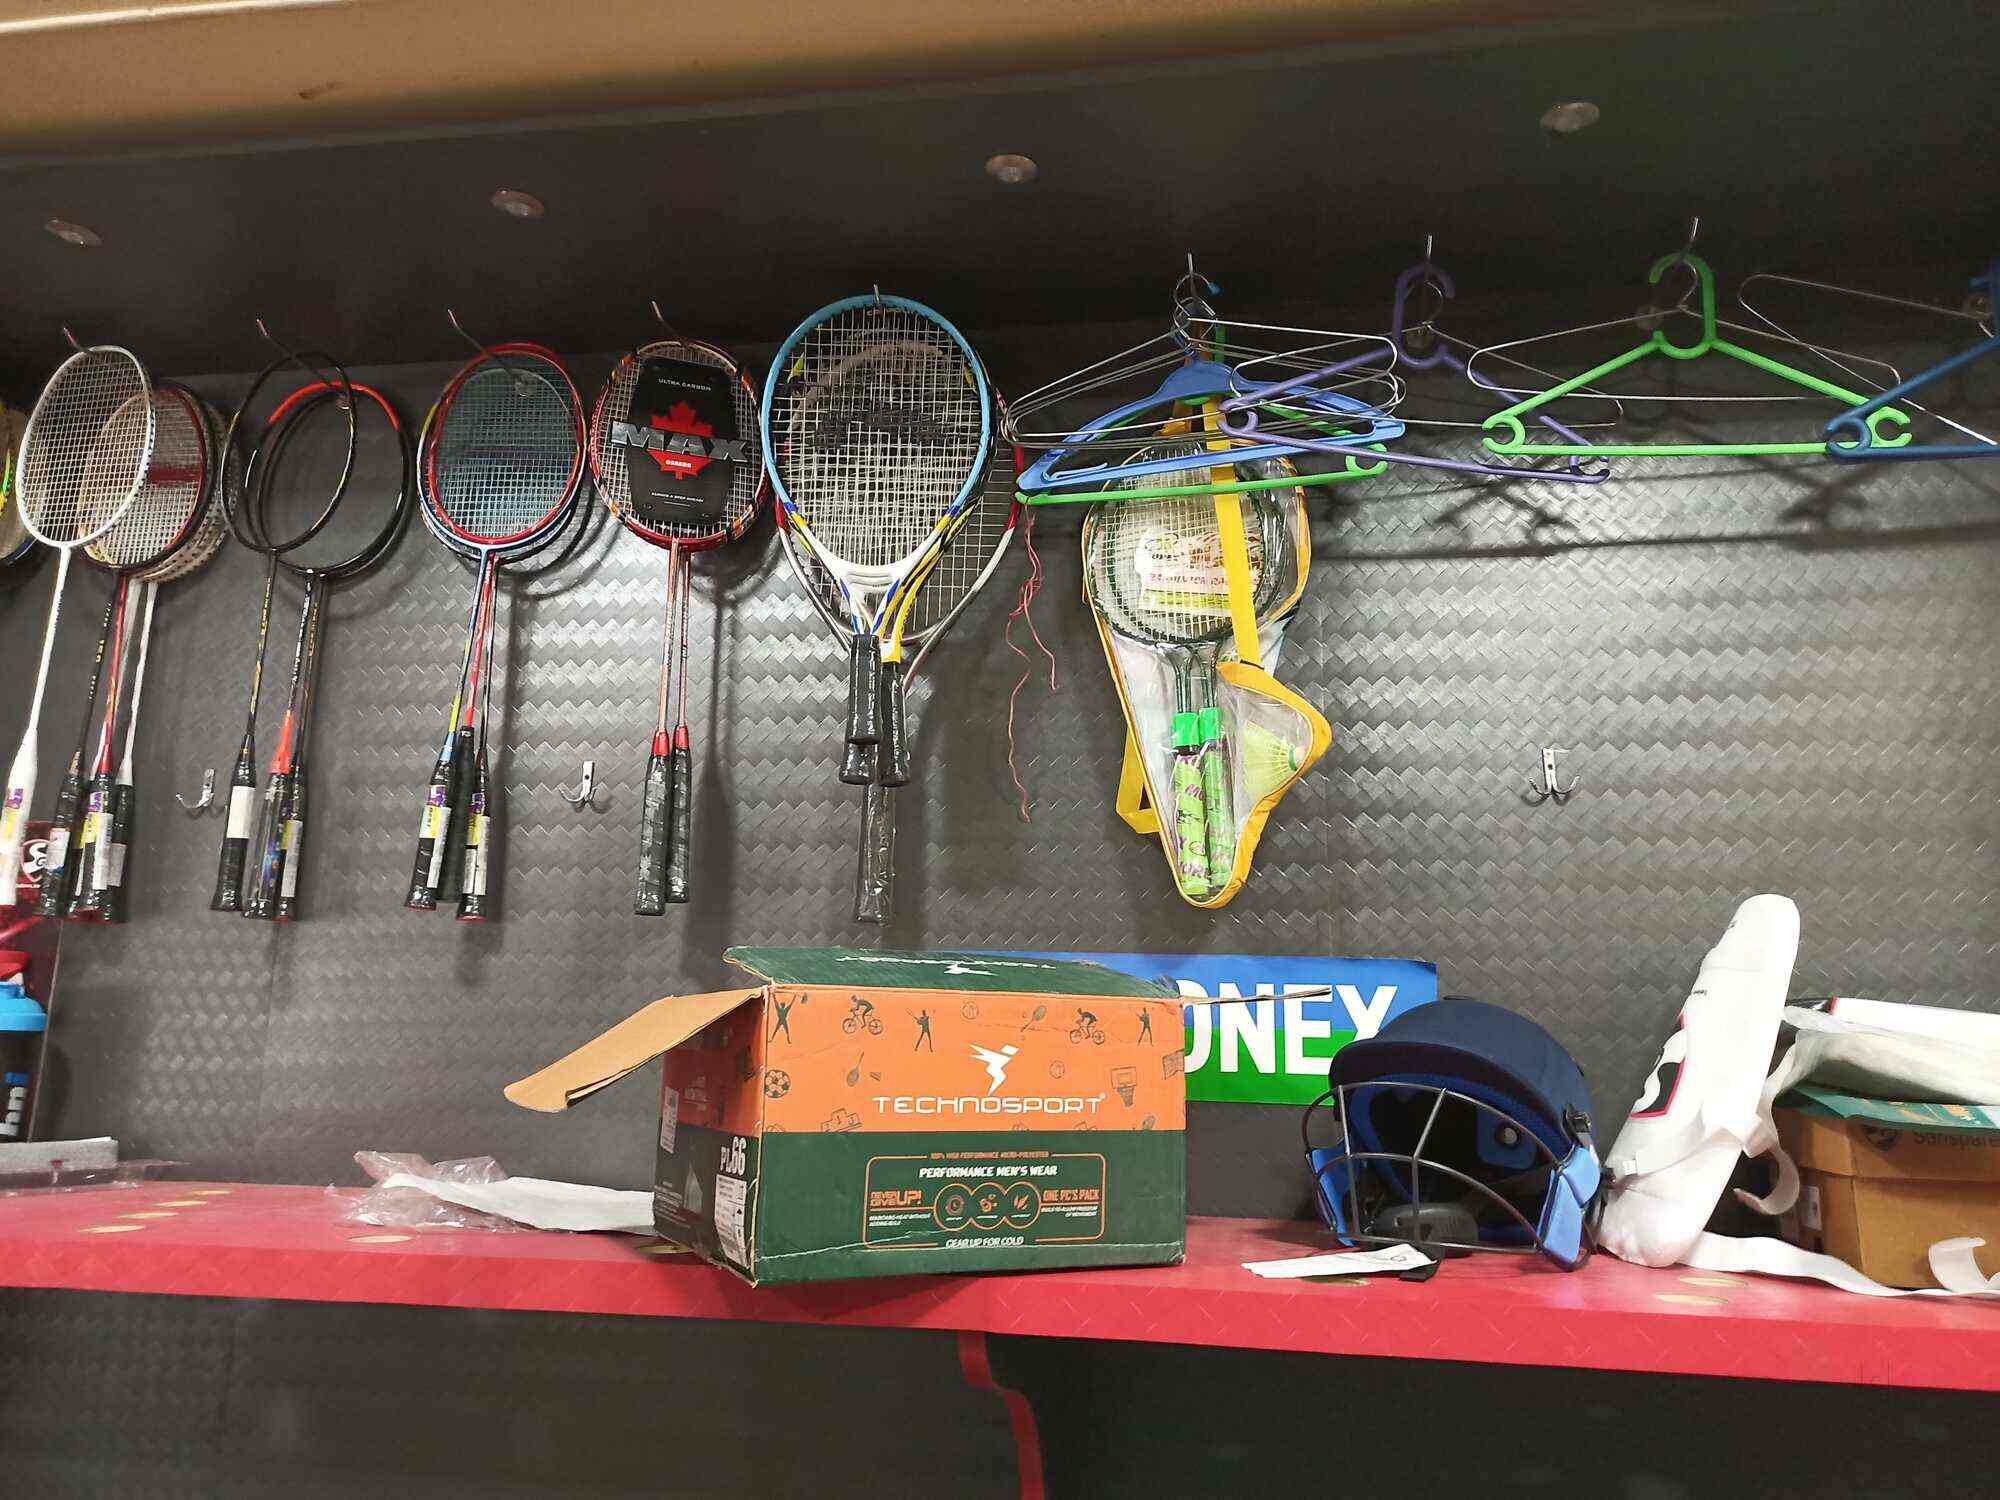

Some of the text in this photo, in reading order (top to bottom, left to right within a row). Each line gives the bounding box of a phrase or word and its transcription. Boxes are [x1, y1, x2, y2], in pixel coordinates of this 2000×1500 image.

[658, 378, 681, 387] ULTRA
[611, 420, 749, 463] MAX
[872, 1095, 1101, 1115] TECHNOSPORT
[919, 1164, 1059, 1179] PERFORMANCE MEN'S WEAR
[896, 1190, 923, 1206] UP!
[1001, 1236, 1025, 1247] COLD
